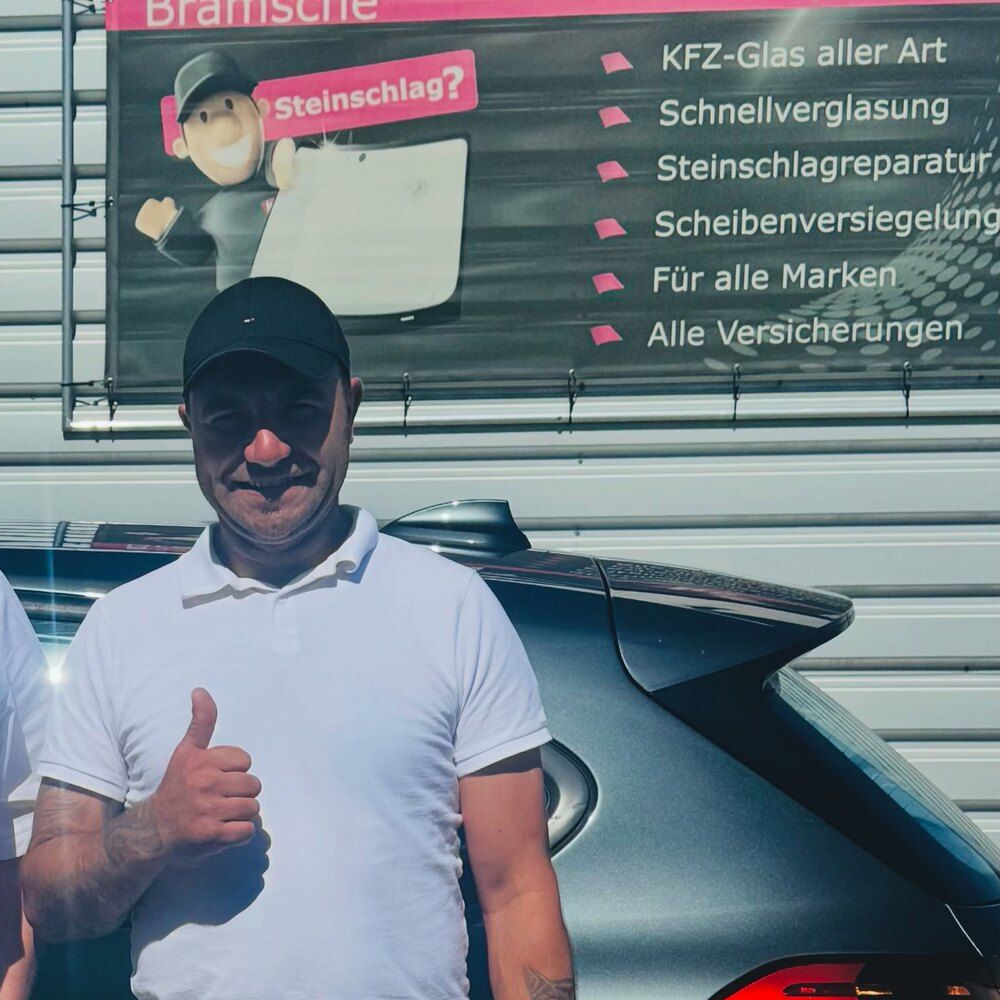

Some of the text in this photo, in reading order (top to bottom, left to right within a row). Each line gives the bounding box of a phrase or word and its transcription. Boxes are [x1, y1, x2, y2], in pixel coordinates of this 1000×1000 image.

[147, 0, 378, 27] Bramsche
[662, 37, 948, 71] KFZ-Glas aller Art
[274, 65, 465, 121] Steinschlag?
[659, 93, 950, 128] Schnellverglasung
[656, 148, 992, 183] Steinschlagreparatur
[654, 203, 1000, 237] Scheibenversiegelung
[653, 260, 897, 293] Für alle Marken
[647, 316, 963, 348] Alle Versicherungen
